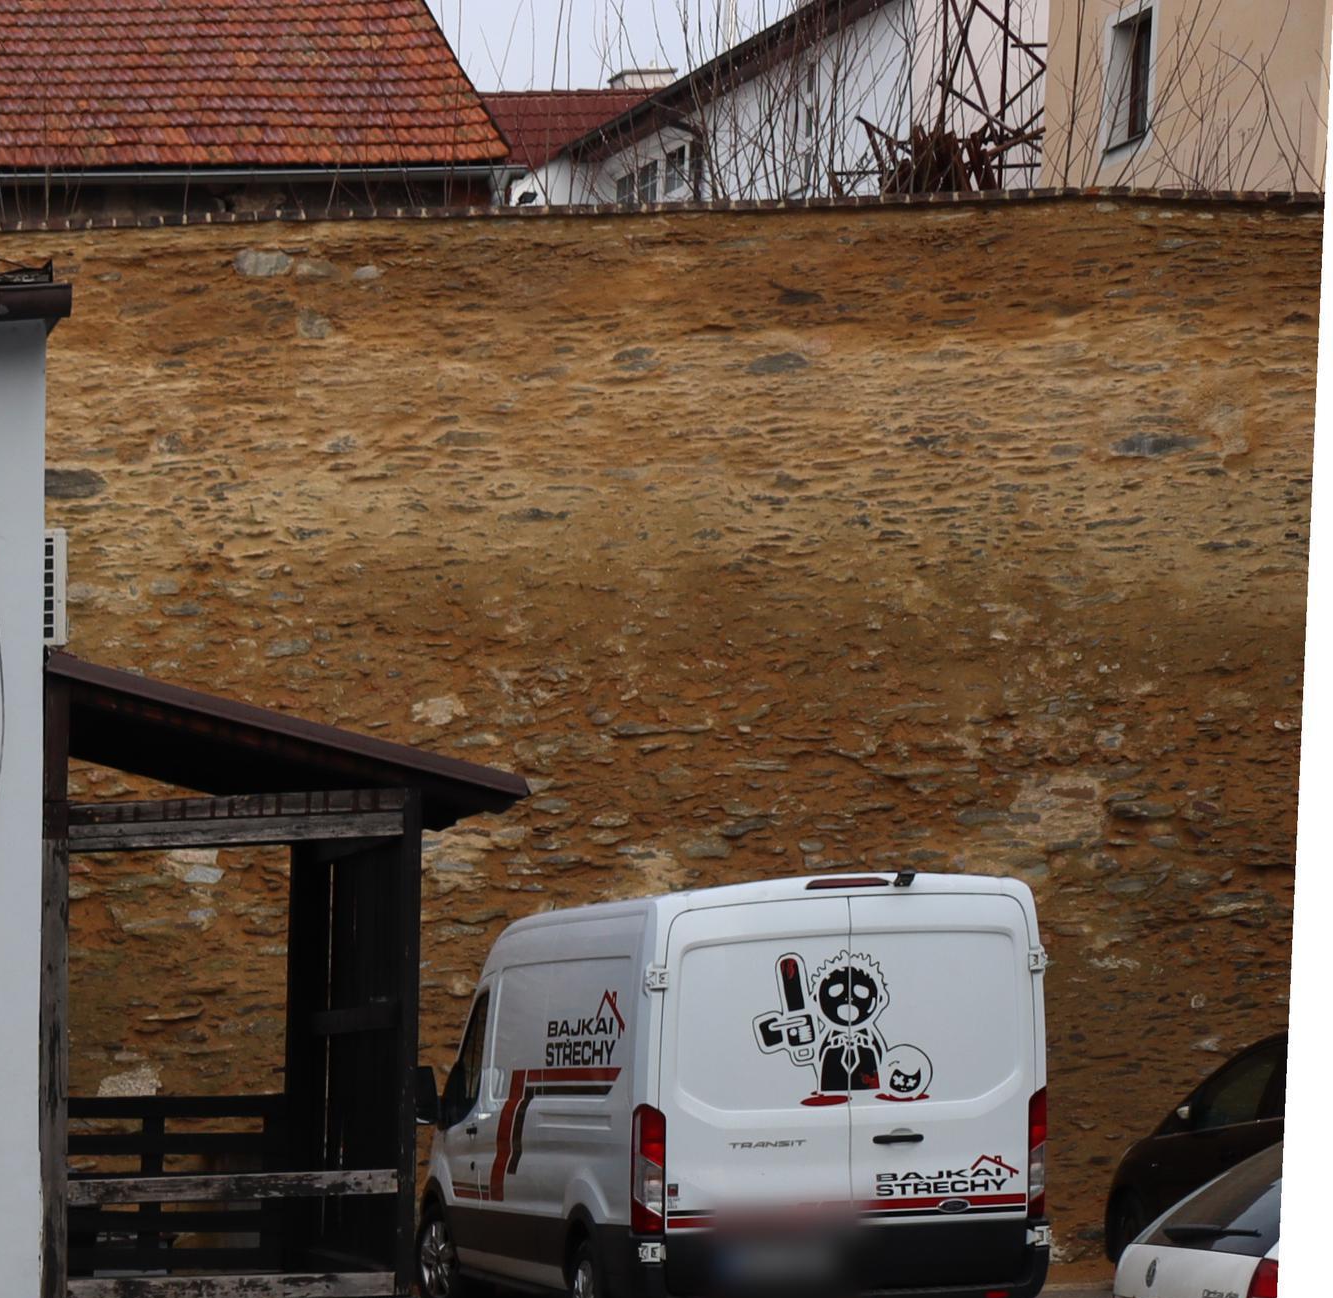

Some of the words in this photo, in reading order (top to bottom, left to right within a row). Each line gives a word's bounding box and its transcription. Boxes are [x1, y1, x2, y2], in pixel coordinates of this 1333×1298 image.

[547, 1017, 614, 1037] BAJKAI
[545, 1039, 616, 1067] STŘECHY
[729, 1139, 806, 1149] TRANSIT
[876, 1167, 1002, 1182] BAJKAI
[876, 1178, 1008, 1196] STŘECHY
